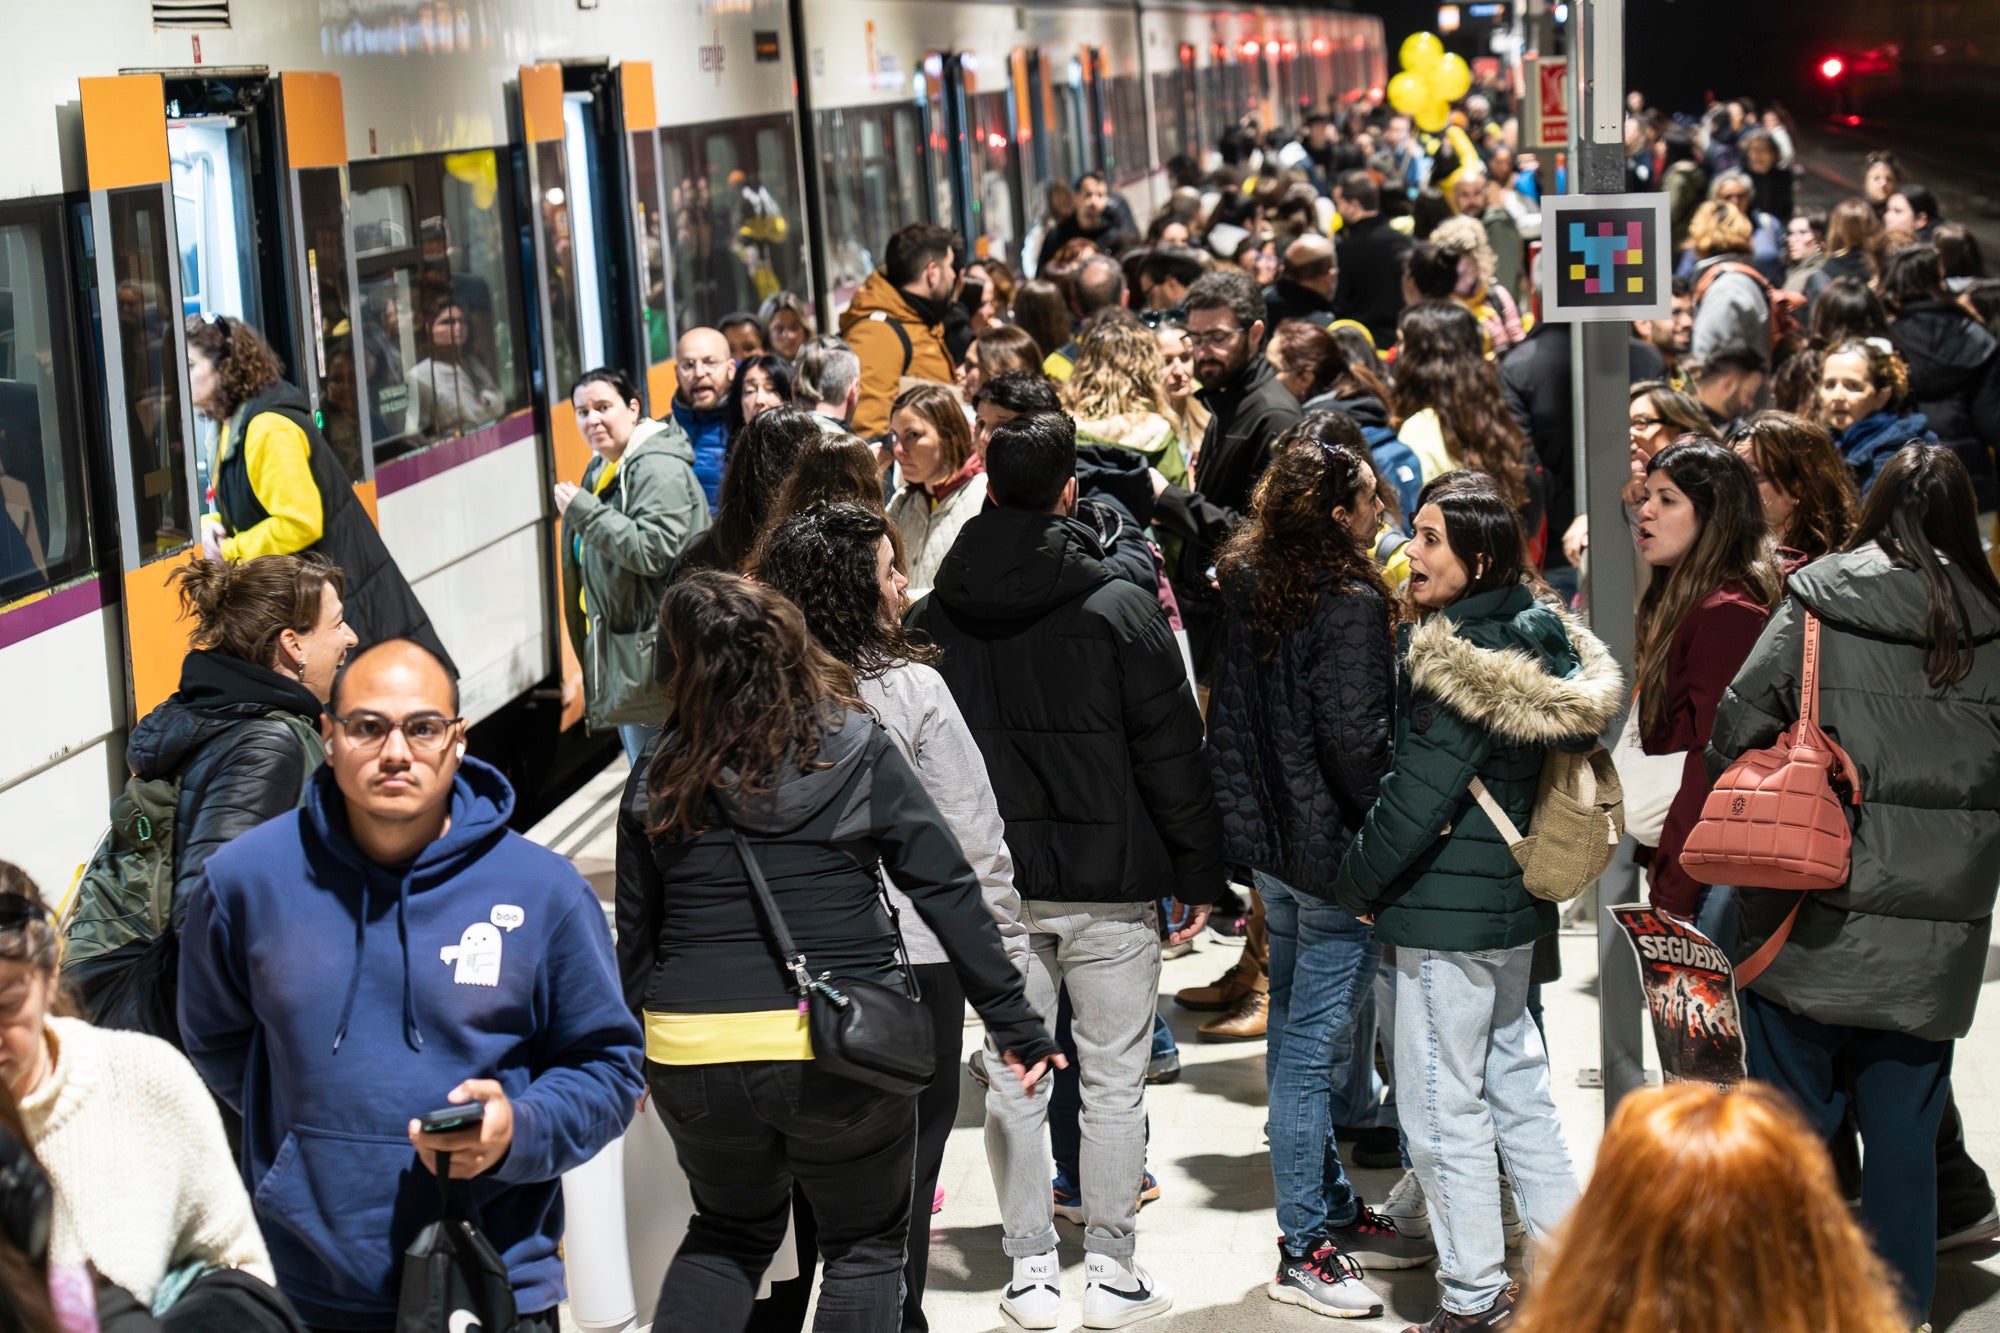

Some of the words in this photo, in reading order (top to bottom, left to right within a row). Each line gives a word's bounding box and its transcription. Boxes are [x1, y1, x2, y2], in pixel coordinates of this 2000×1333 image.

[495, 911, 519, 922] boo
[1623, 913, 1667, 935] LA
[1638, 935, 1730, 975] SEGUEIX!
[1030, 1265, 1048, 1274] NIKE
[1089, 1264, 1105, 1273] NIKE
[1287, 1268, 1317, 1291] adidas
